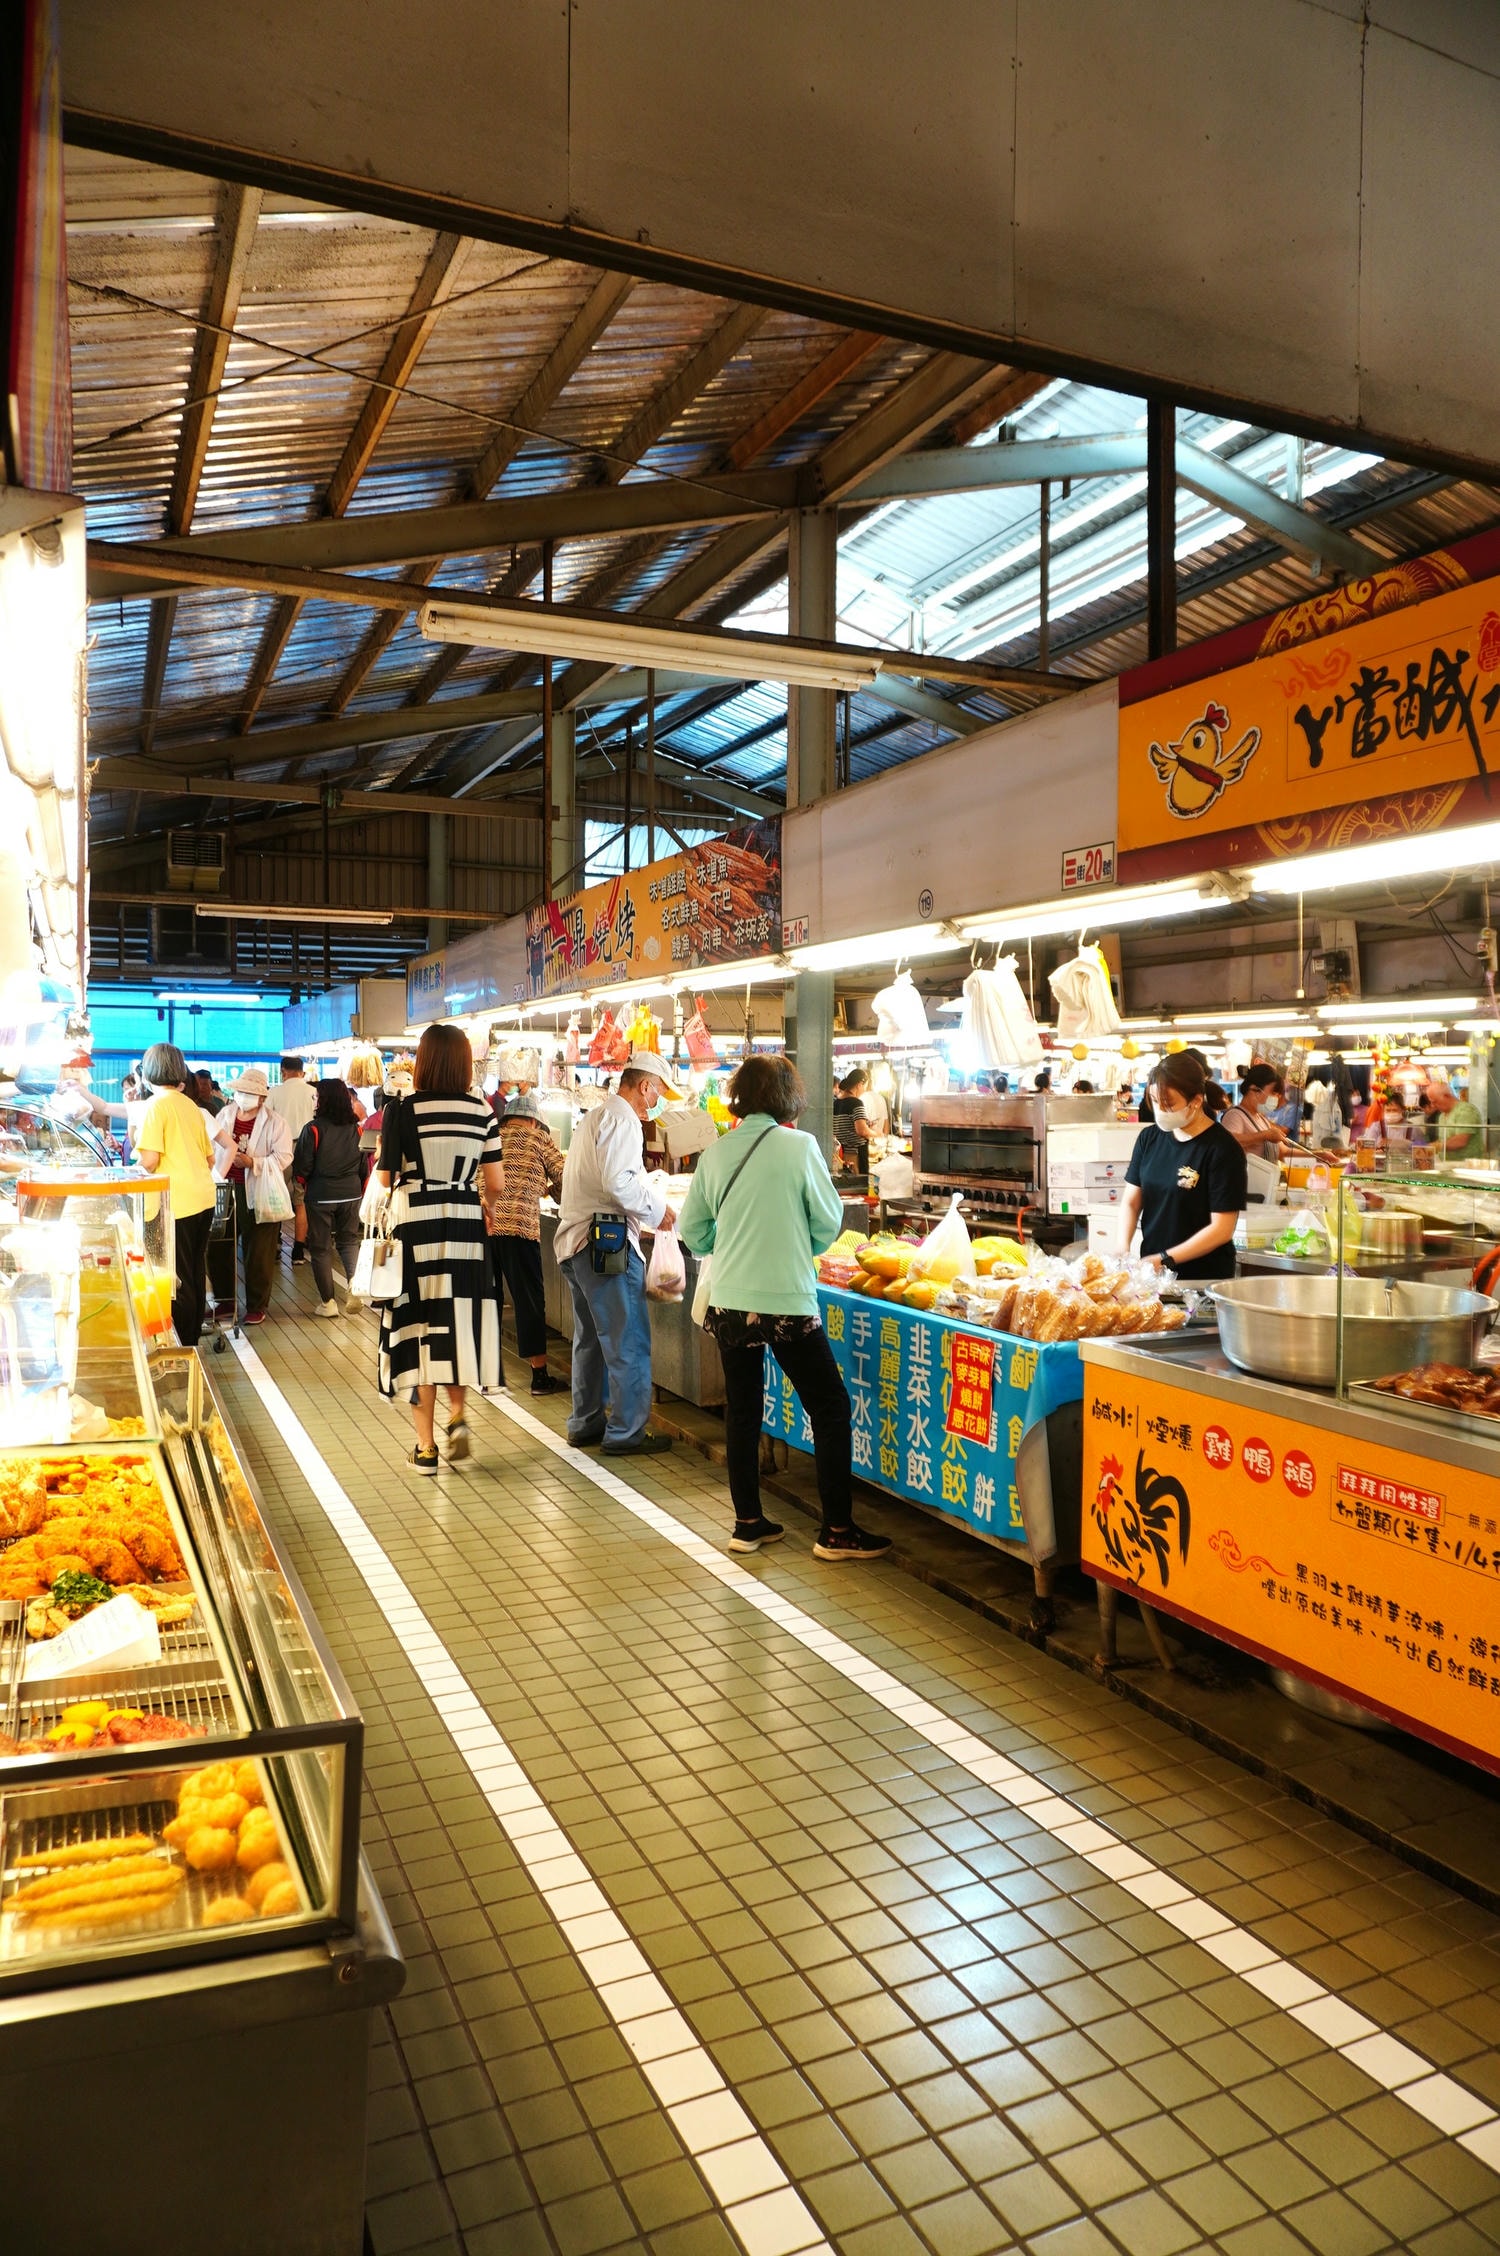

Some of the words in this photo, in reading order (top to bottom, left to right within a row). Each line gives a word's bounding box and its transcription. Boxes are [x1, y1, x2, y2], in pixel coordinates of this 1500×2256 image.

[550, 889, 636, 969] 一鼎燒烤
[851, 1311, 873, 1469] 手工水餃
[879, 1316, 901, 1482] 高麗菜水餃
[907, 1322, 933, 1494] 韭菜水餃
[955, 1362, 990, 1390] 麥芽糖
[956, 1340, 991, 1366] 古早味
